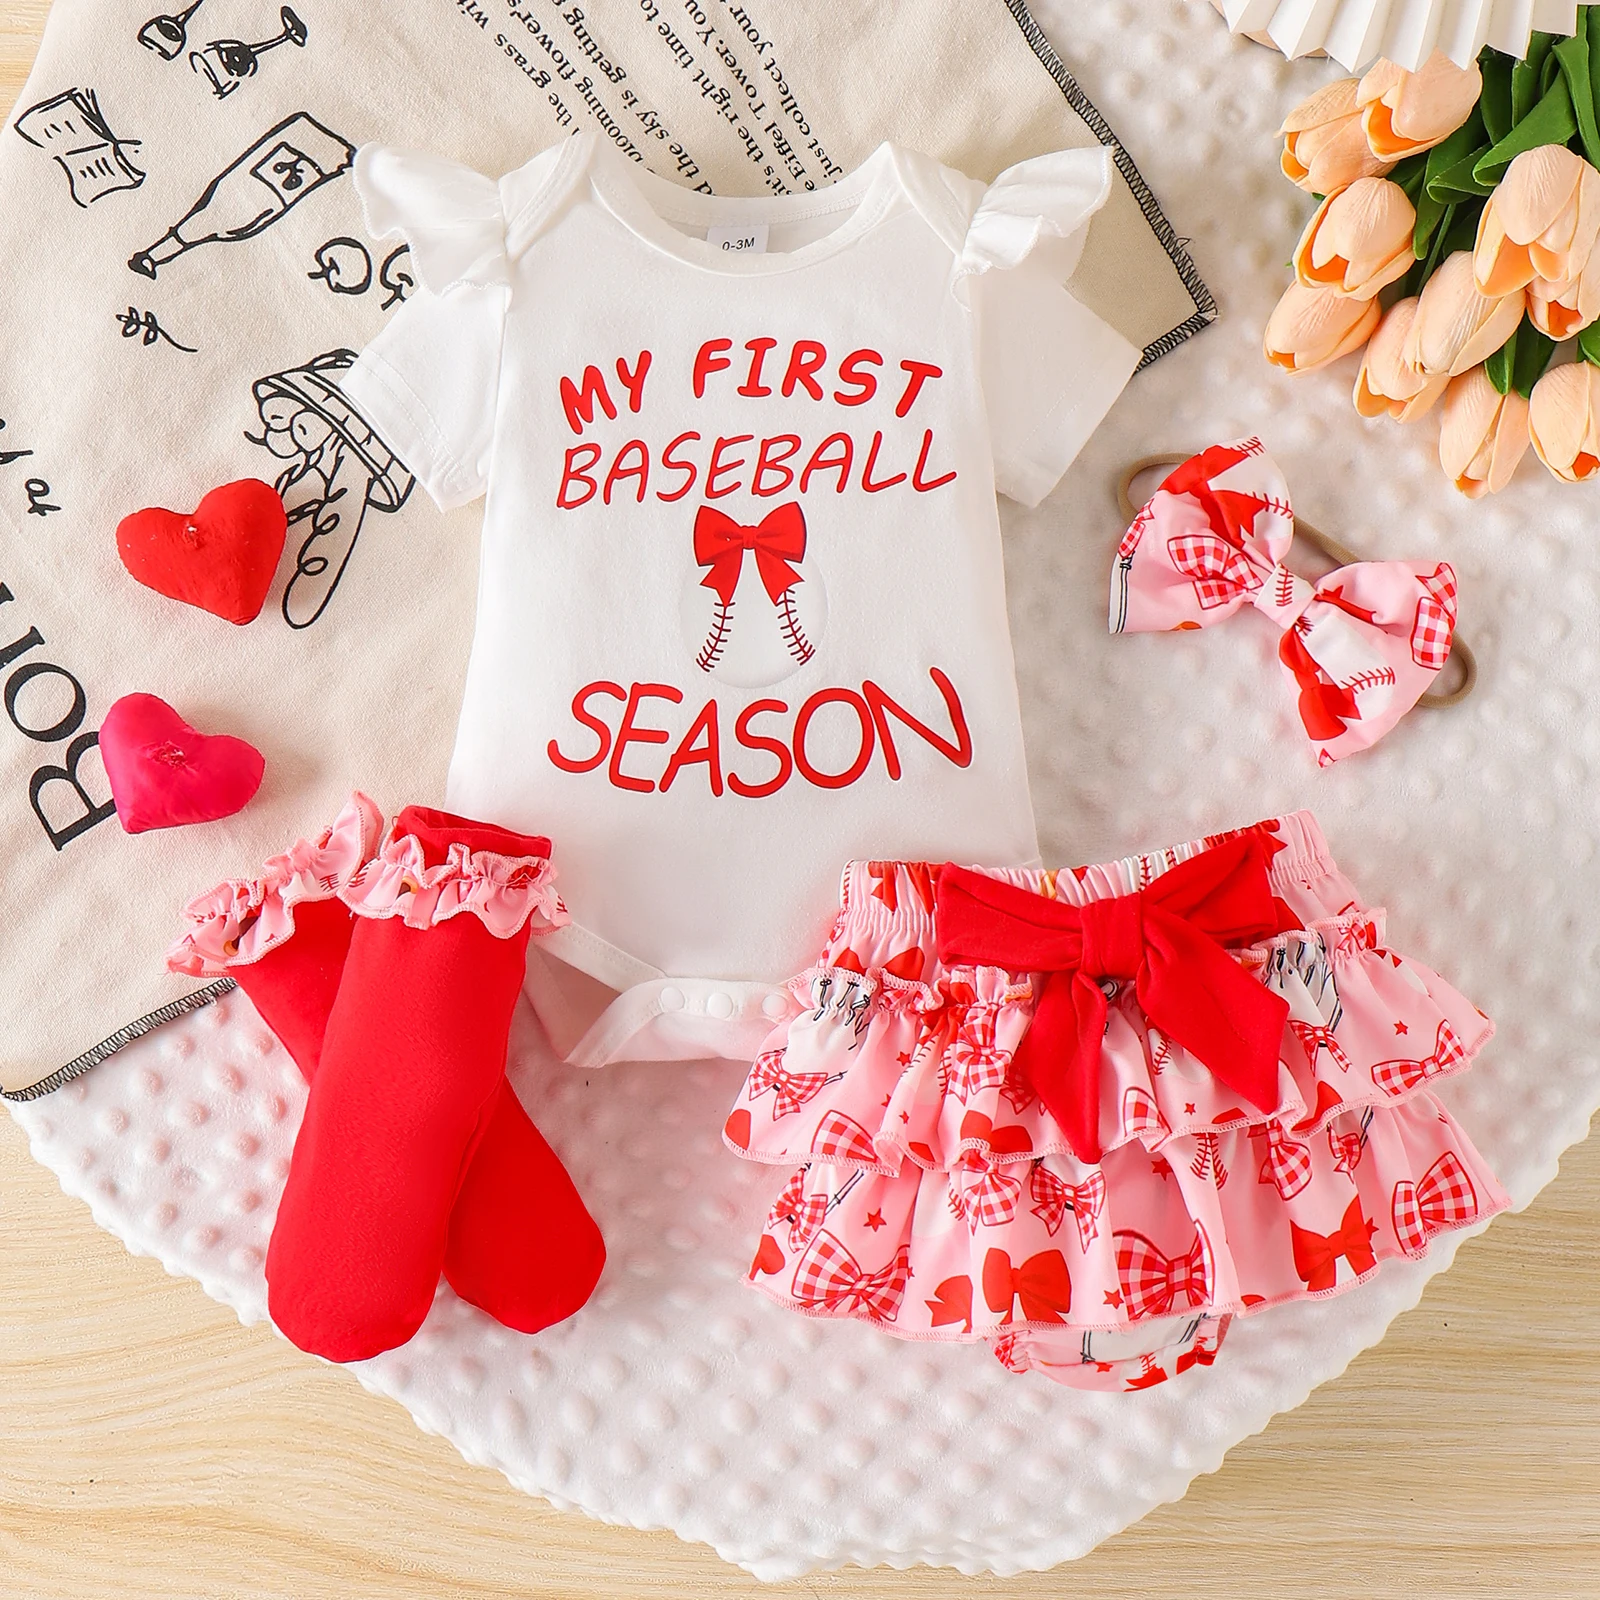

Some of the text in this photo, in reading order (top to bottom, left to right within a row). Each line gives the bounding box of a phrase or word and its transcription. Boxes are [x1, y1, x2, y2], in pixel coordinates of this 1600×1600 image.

[640, 0, 659, 22] to
[494, 33, 552, 89] grass
[657, 22, 694, 69] time
[548, 92, 573, 127] the
[562, 7, 700, 179] the sky is getting
[692, 69, 740, 125] right
[729, 7, 843, 179] just collect your
[737, 125, 764, 164] the
[764, 120, 807, 181] Eiffel
[721, 236, 756, 252] 0-3M
[559, 336, 944, 435] MY FIRST
[555, 429, 958, 510] BASEBALL
[546, 666, 973, 799] SEASON
